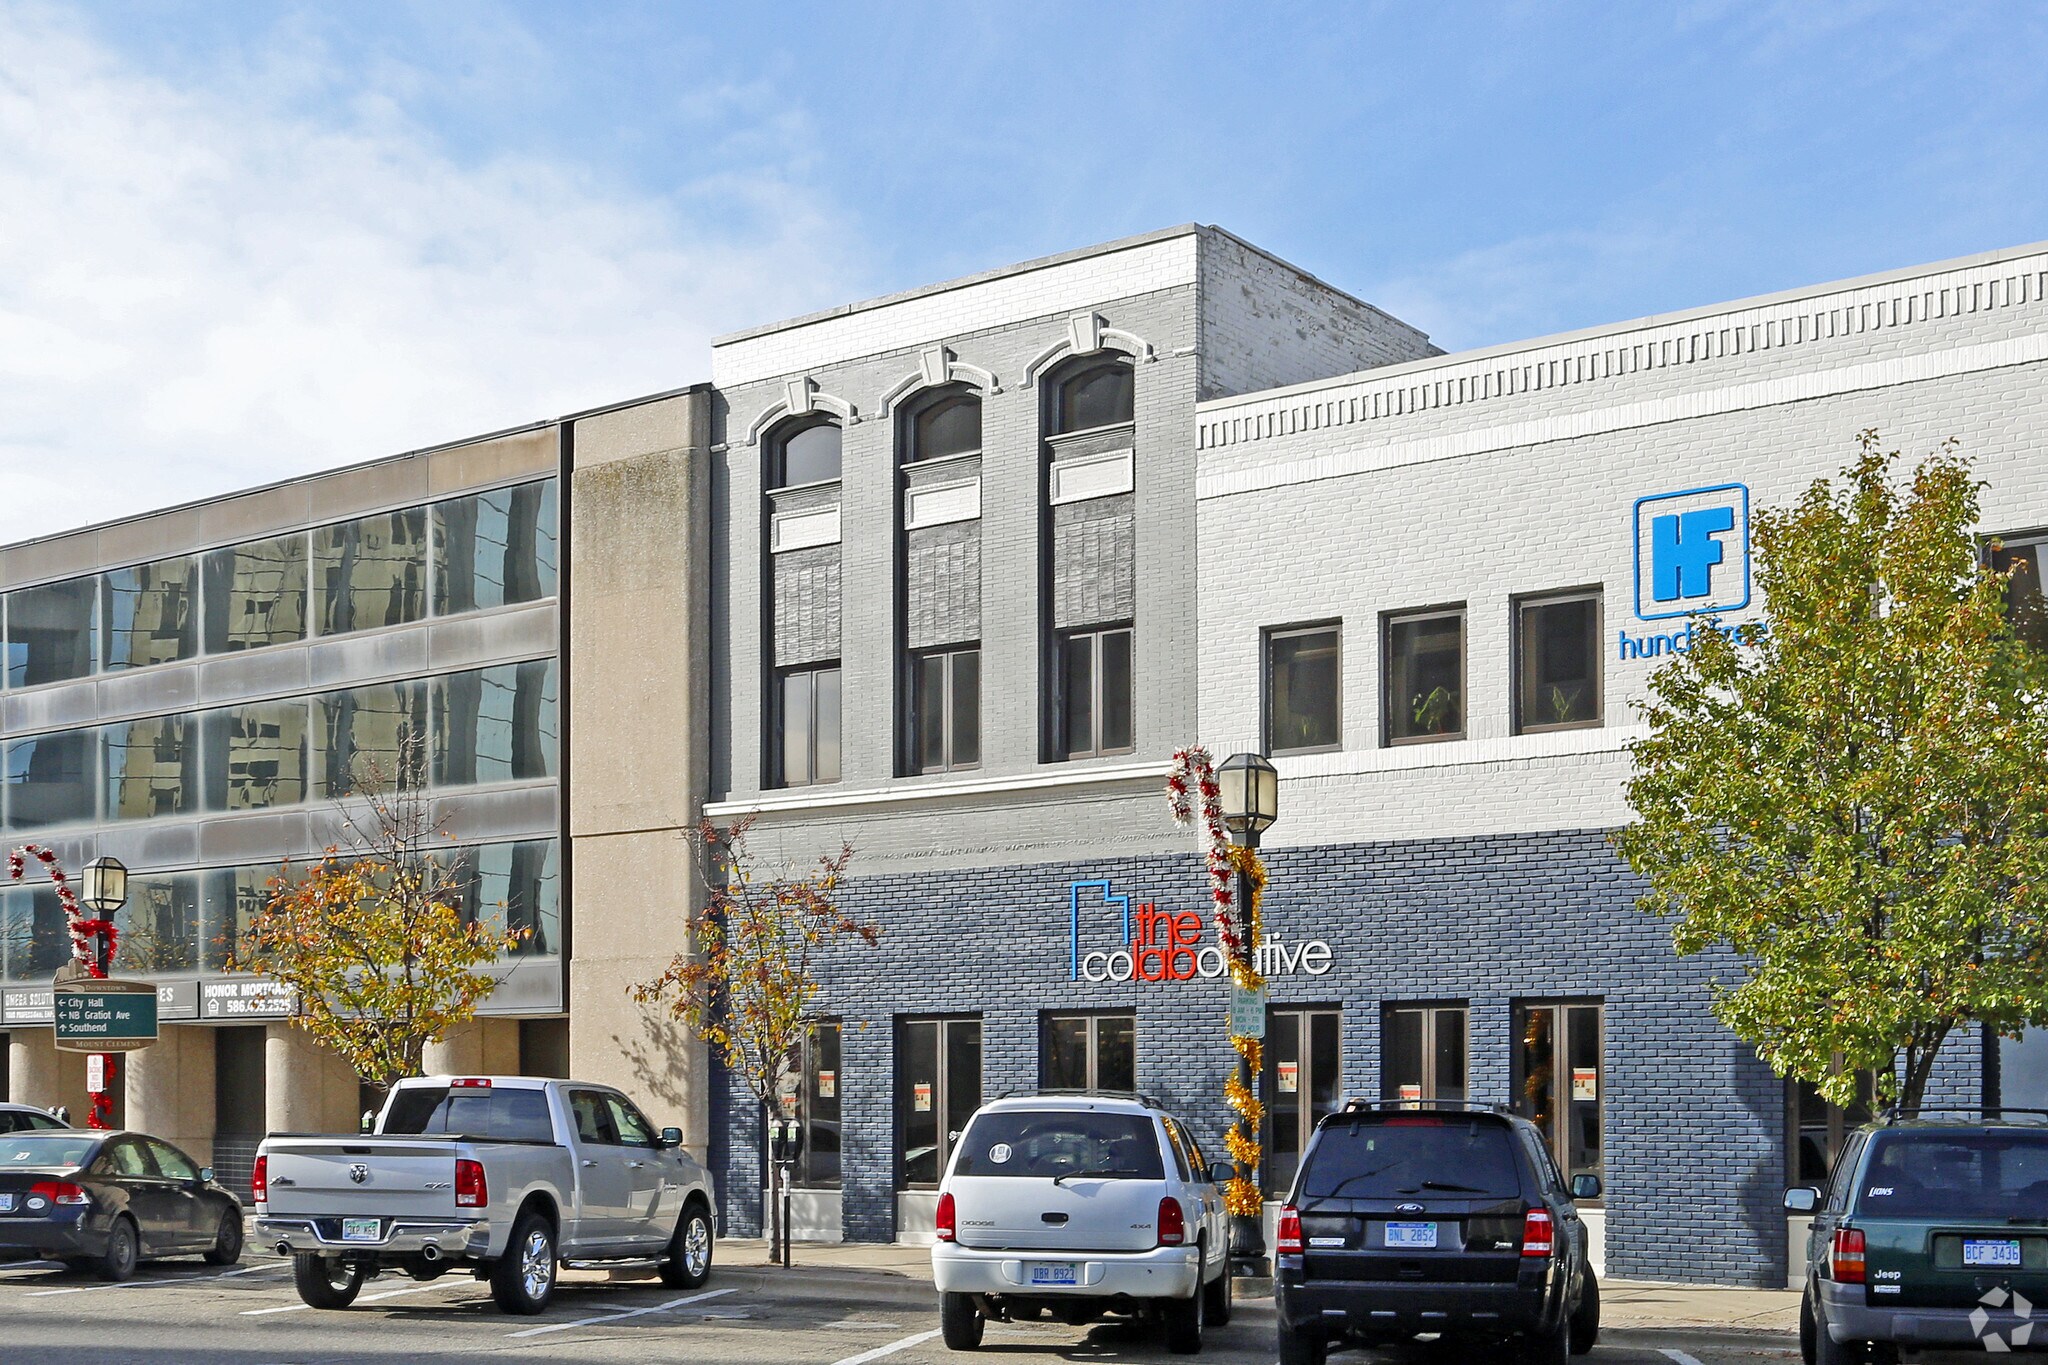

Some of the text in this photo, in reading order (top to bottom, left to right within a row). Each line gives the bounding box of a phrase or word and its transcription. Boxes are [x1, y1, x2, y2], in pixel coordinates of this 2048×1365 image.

[1652, 506, 1734, 602] HF
[1135, 902, 1202, 945] the
[204, 984, 238, 997] HONOR
[68, 998, 104, 1008] City Hall
[1237, 997, 1257, 1005] PARKING
[68, 1010, 130, 1020] NB Gratiot Ave
[69, 1023, 107, 1032] Southend
[1388, 1229, 1434, 1241] BNL 2852
[1966, 1246, 2019, 1260] BCF 3436
[1054, 1268, 1075, 1280] 8923
[1874, 1269, 1901, 1280] Jeep
